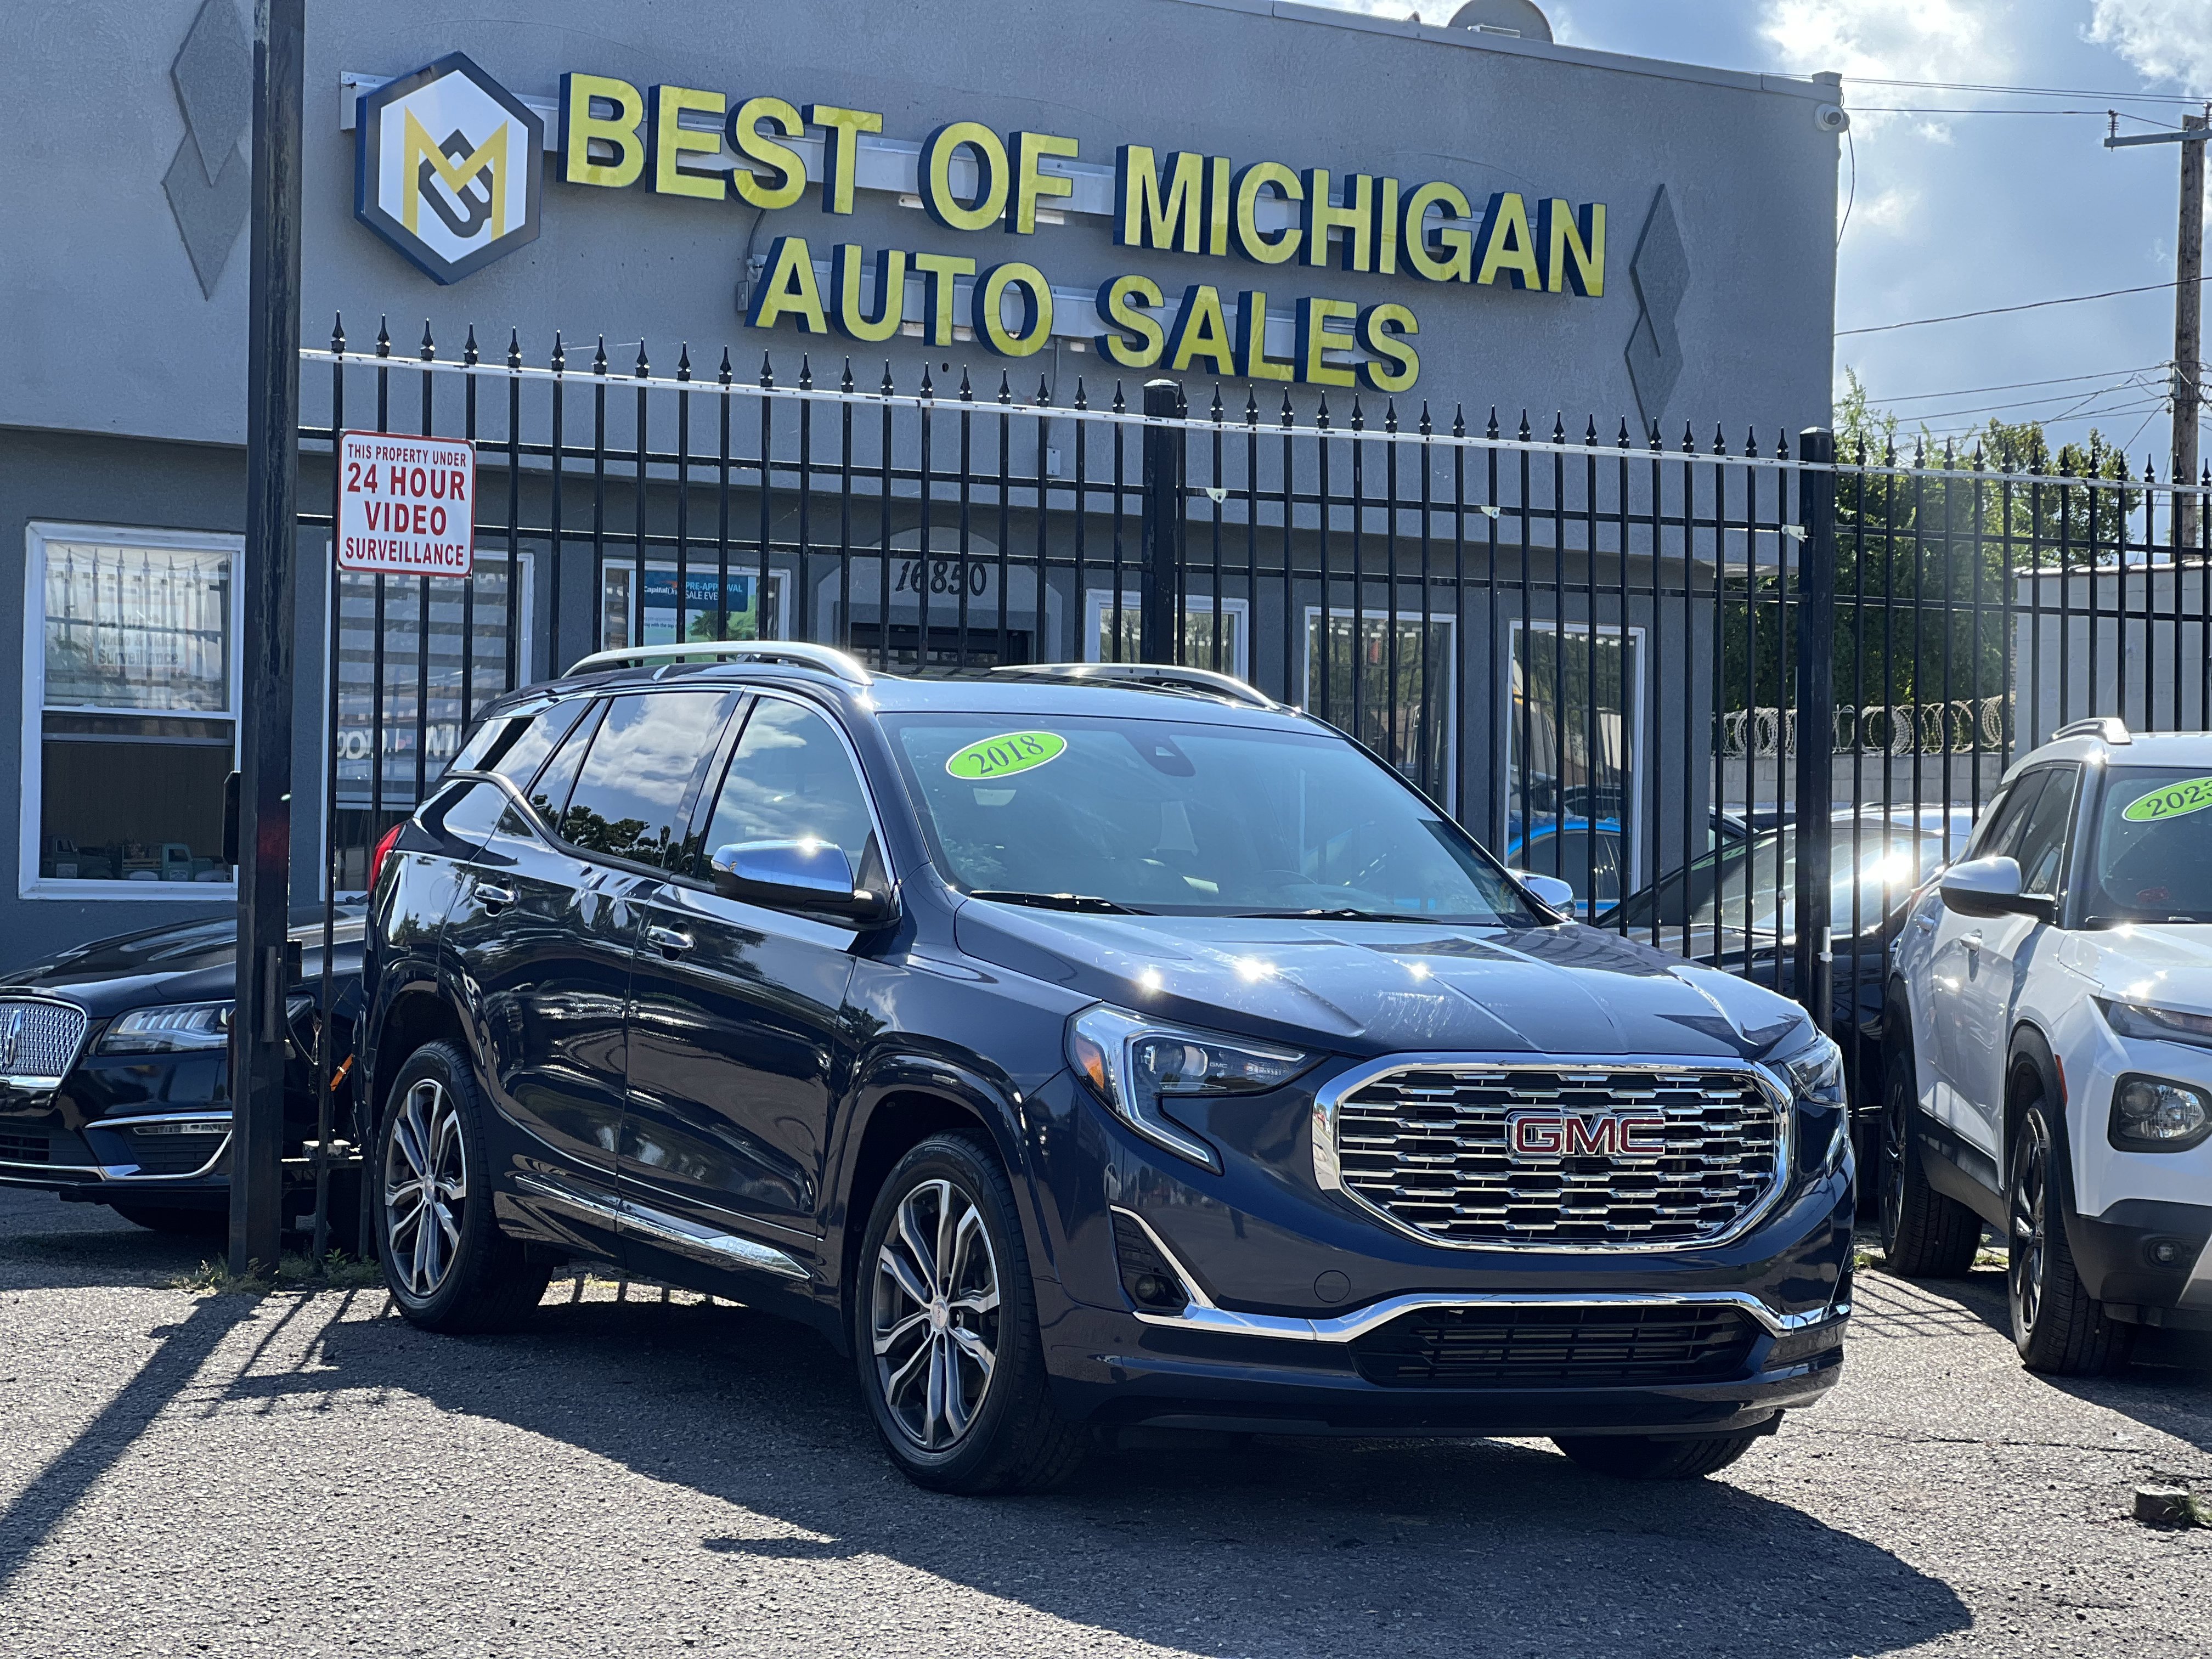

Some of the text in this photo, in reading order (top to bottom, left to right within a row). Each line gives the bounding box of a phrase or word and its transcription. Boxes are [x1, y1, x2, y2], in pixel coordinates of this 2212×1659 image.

[558, 72, 1606, 297] BEST OF MICHIGAN
[745, 236, 1420, 392] AUTO SALES
[348, 444, 466, 467] THIS PROPERTY UNDER
[347, 462, 465, 501] 24 HOUR
[364, 500, 446, 536] VIDEO
[345, 537, 464, 566] SURVEILLANCE
[685, 590, 718, 601] SALE EVE
[686, 582, 743, 592] PRE-APPVAL
[969, 736, 1044, 775] 2018
[1513, 1115, 1666, 1156] GMC
